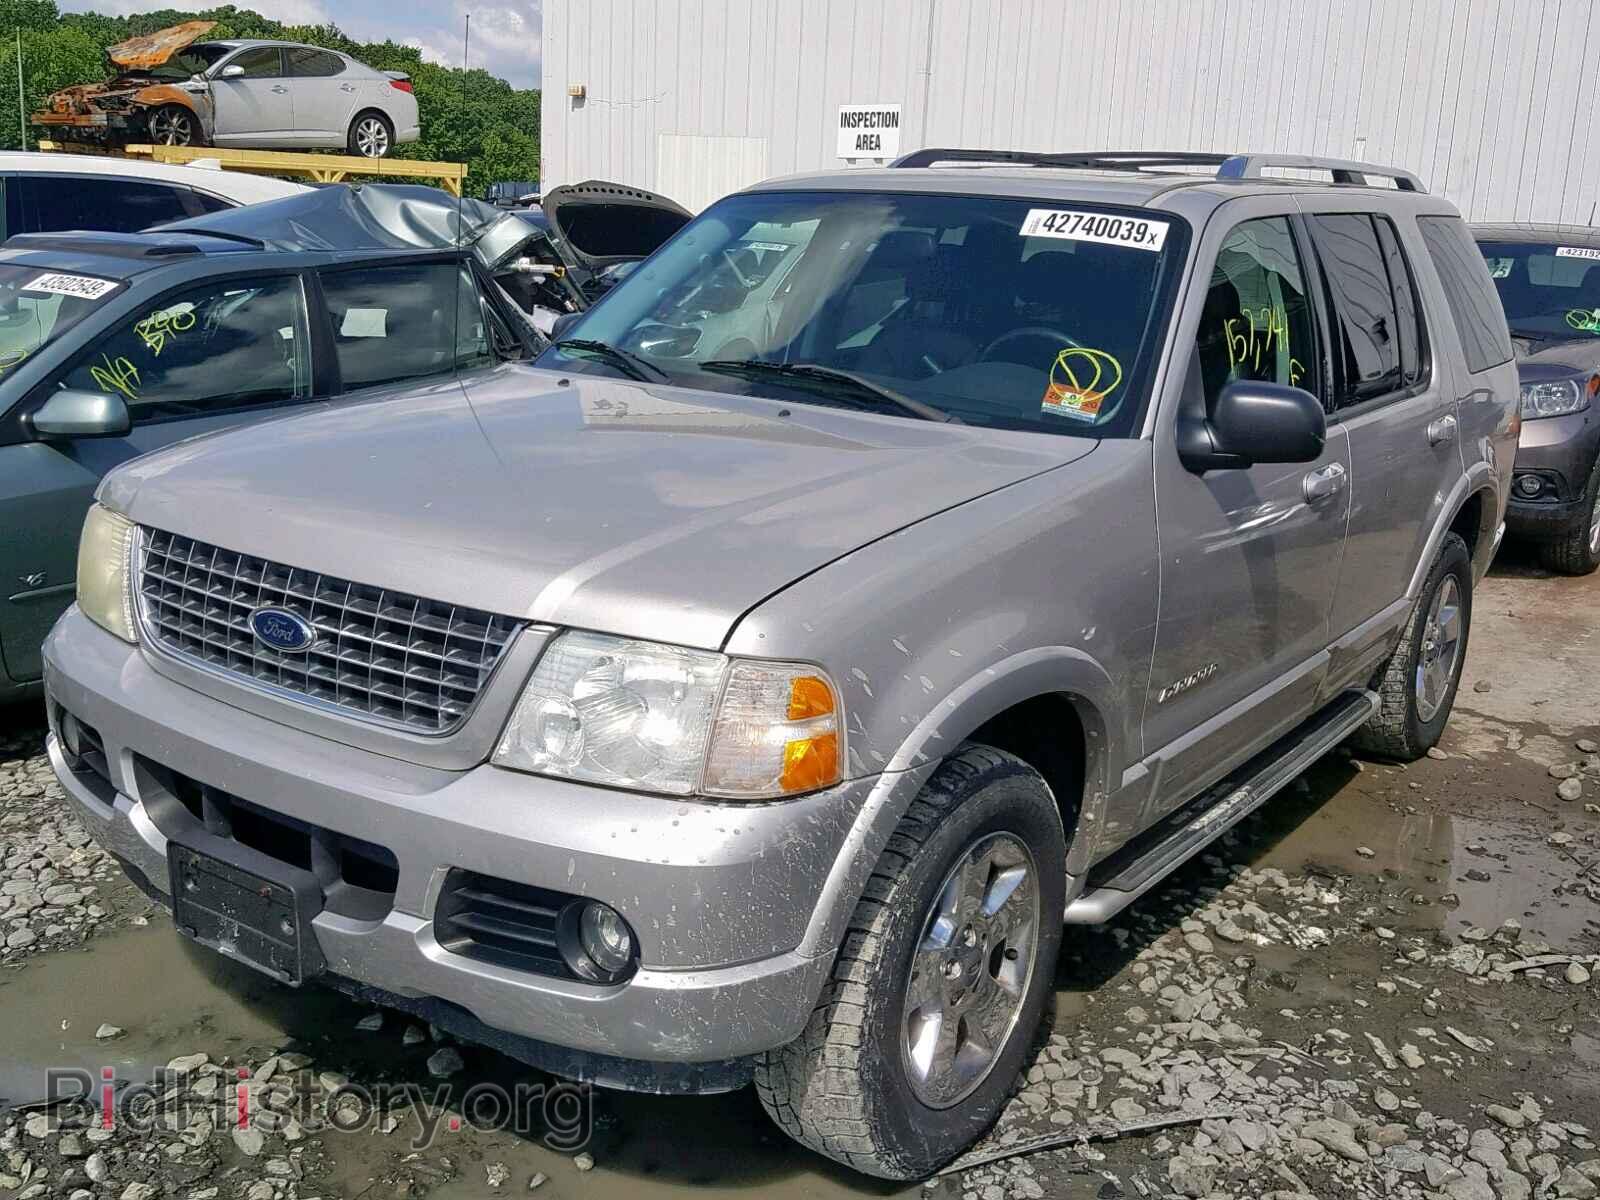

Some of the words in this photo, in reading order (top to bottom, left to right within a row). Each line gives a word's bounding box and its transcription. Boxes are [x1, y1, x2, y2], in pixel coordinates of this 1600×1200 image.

[840, 111, 899, 128] INSPECTION
[855, 133, 881, 150] AREA
[1043, 213, 1149, 243] 42740039
[263, 616, 295, 642] Ford
